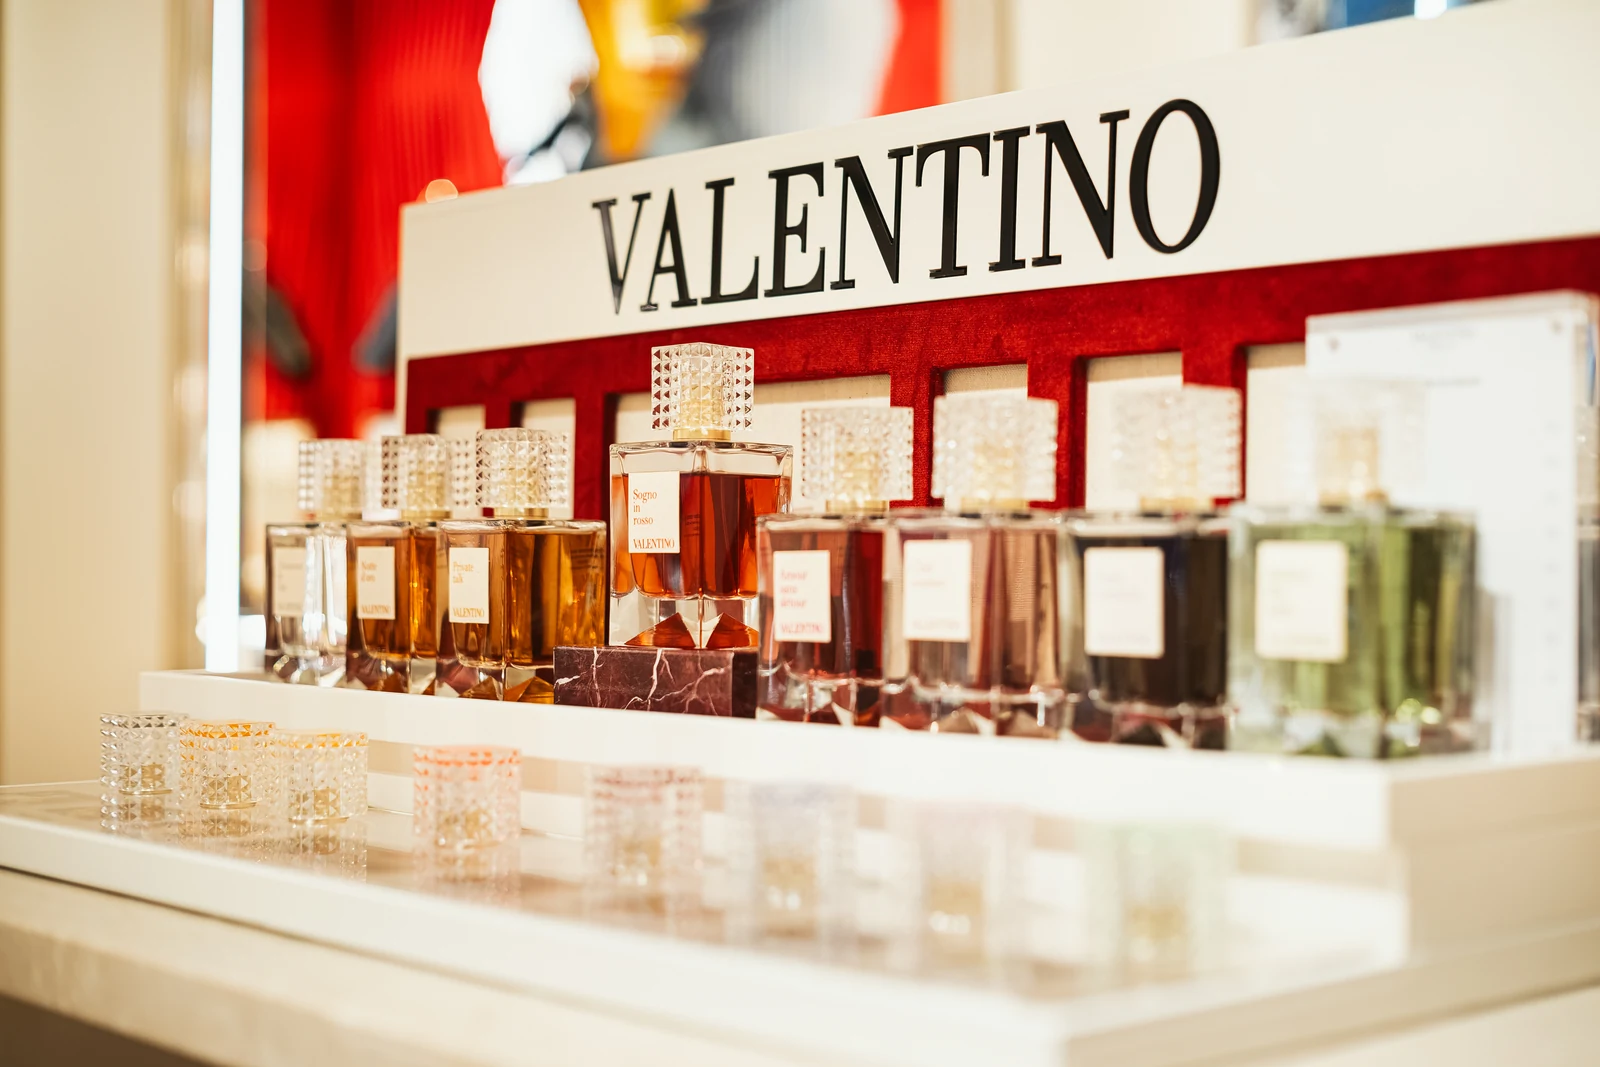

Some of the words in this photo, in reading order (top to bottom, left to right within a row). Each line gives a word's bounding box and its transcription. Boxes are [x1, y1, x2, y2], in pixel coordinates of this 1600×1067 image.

[592, 98, 1221, 314] VALENTINO
[633, 488, 658, 503] Sogno
[633, 502, 641, 512] in
[633, 516, 654, 526] rosso
[633, 538, 675, 549] VALENTINO
[453, 562, 474, 572] Private
[453, 607, 485, 618] VALENTINO
